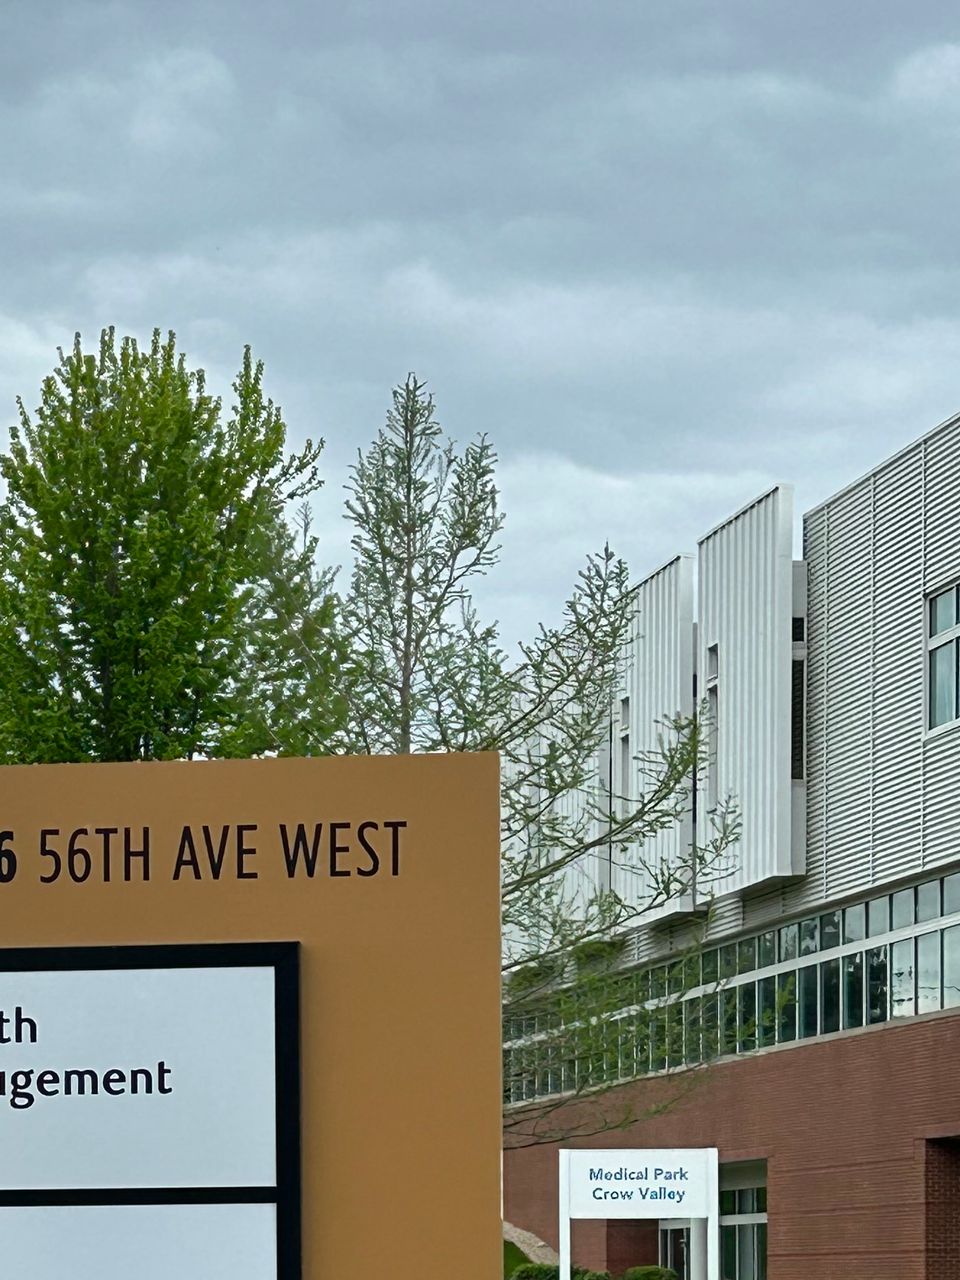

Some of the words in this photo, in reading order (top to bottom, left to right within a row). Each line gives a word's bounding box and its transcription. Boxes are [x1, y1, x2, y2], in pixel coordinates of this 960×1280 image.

[39, 826, 151, 883] 56TH
[172, 824, 259, 880] AVE
[278, 820, 409, 878] WEST
[589, 1167, 648, 1181] Medical
[654, 1167, 689, 1181] Park
[592, 1187, 634, 1200] Crow
[639, 1187, 686, 1203] Valley
